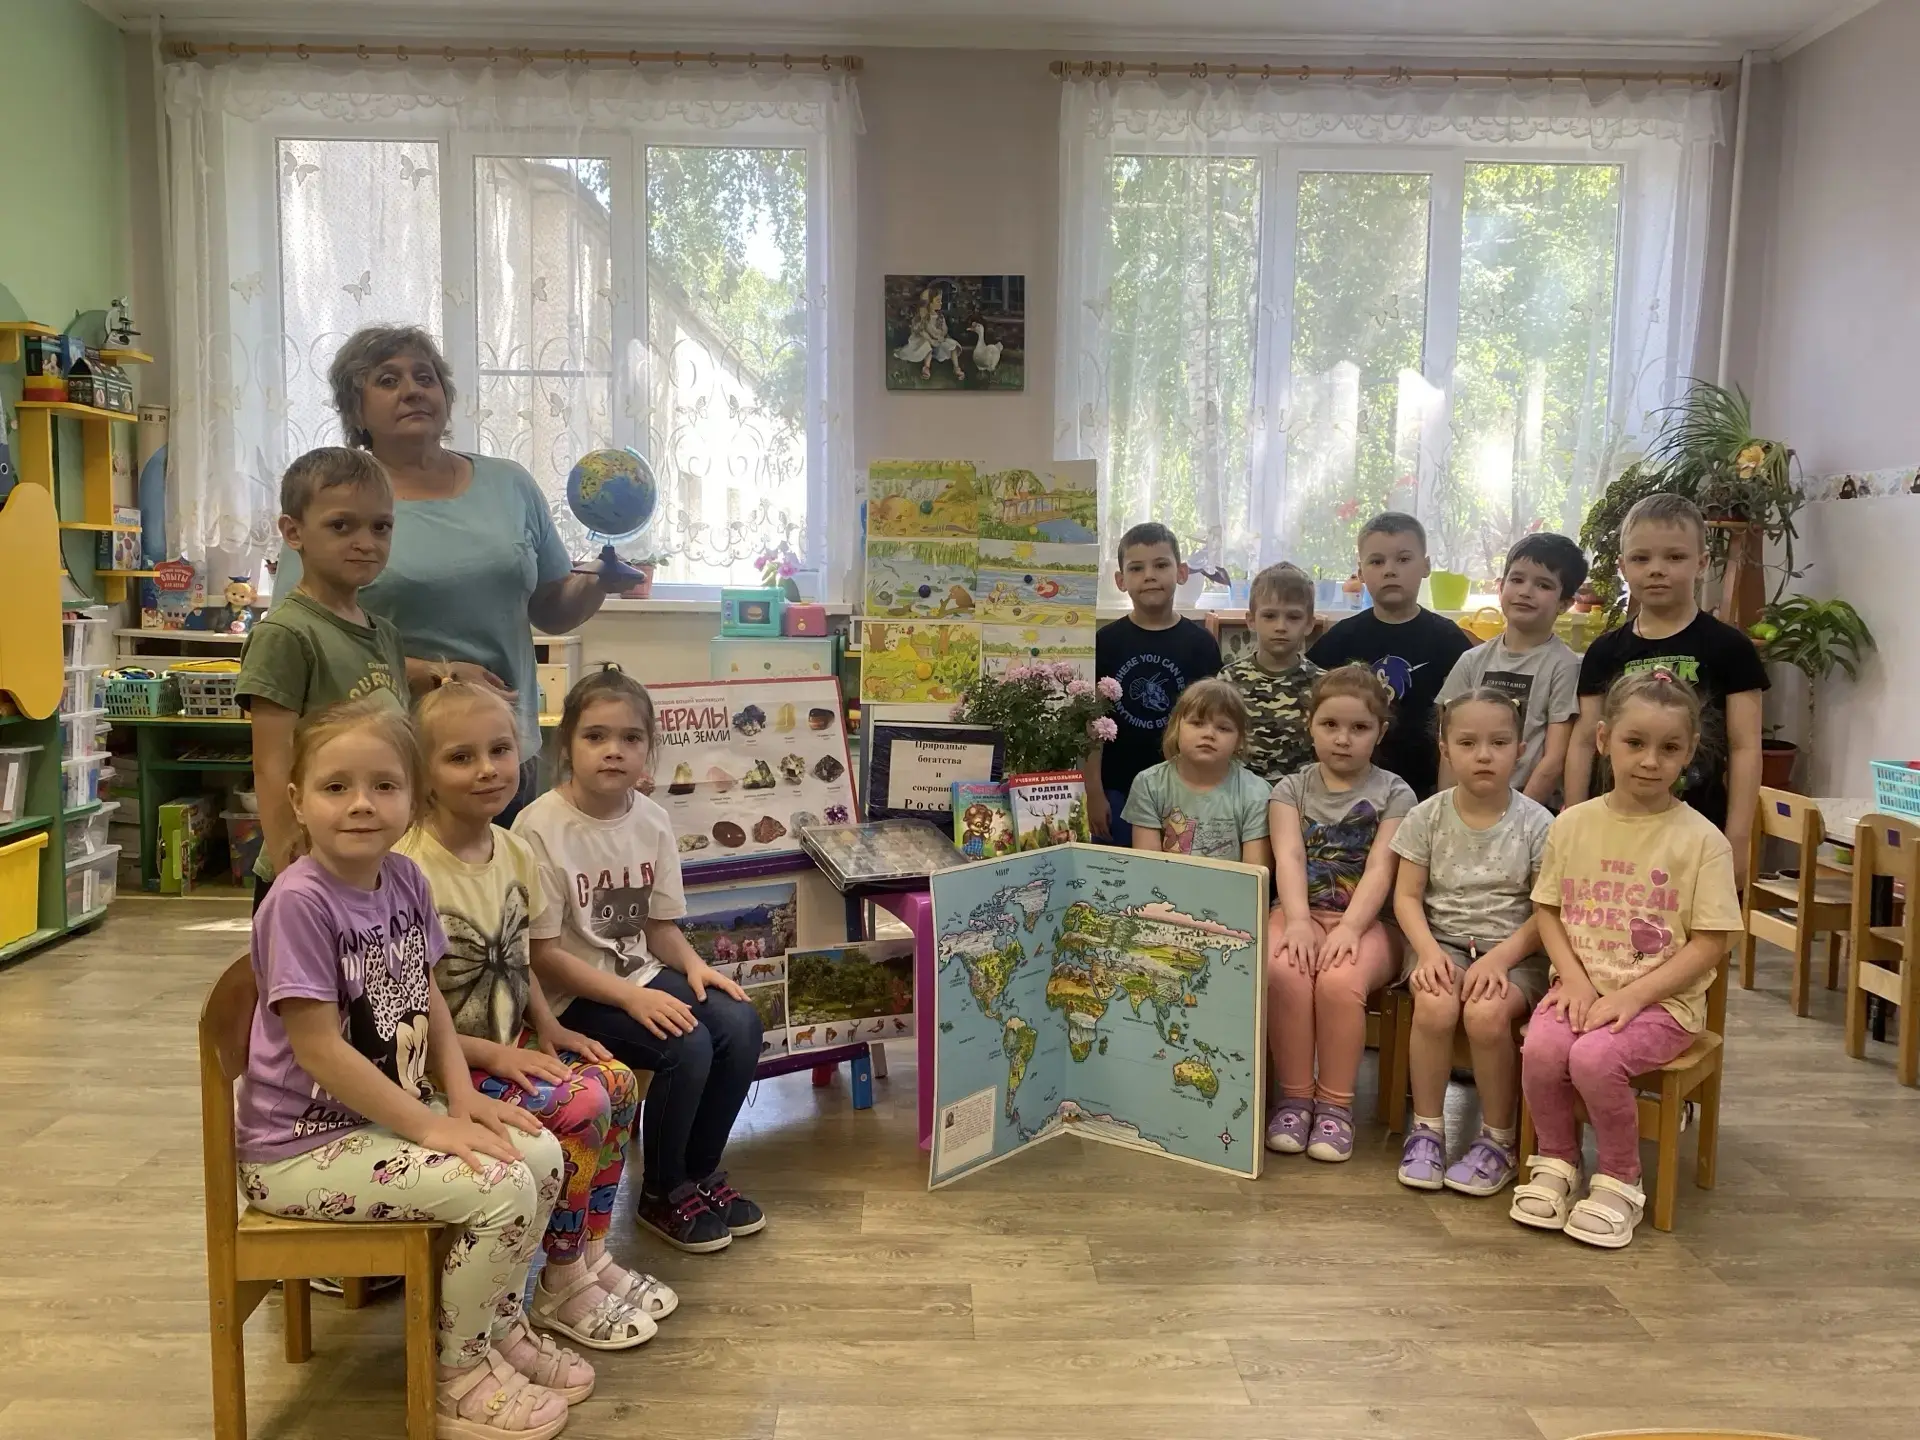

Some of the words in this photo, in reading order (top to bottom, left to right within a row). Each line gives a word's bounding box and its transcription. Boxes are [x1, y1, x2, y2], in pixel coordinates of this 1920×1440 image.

[138, 413, 166, 422] ИР
[1140, 654, 1160, 663] YOU
[1162, 658, 1181, 676] CAN
[1176, 676, 1186, 690] BE
[655, 706, 729, 731] НЕРАЛЫ
[1115, 701, 1153, 729] NYTHING
[655, 731, 690, 747] ВИЩА
[693, 729, 731, 744] ЗЕМЛИ
[915, 740, 968, 751] Природные
[917, 754, 962, 765] богатства
[1015, 776, 1040, 784] УЧЕБНИК
[1041, 773, 1083, 783] ДОШКОЛЬНИКА
[912, 785, 952, 794] сокрови
[1031, 785, 1069, 793] РОДНАЯ
[1029, 793, 1073, 801] ПРИРОДА
[1600, 859, 1637, 876] THE
